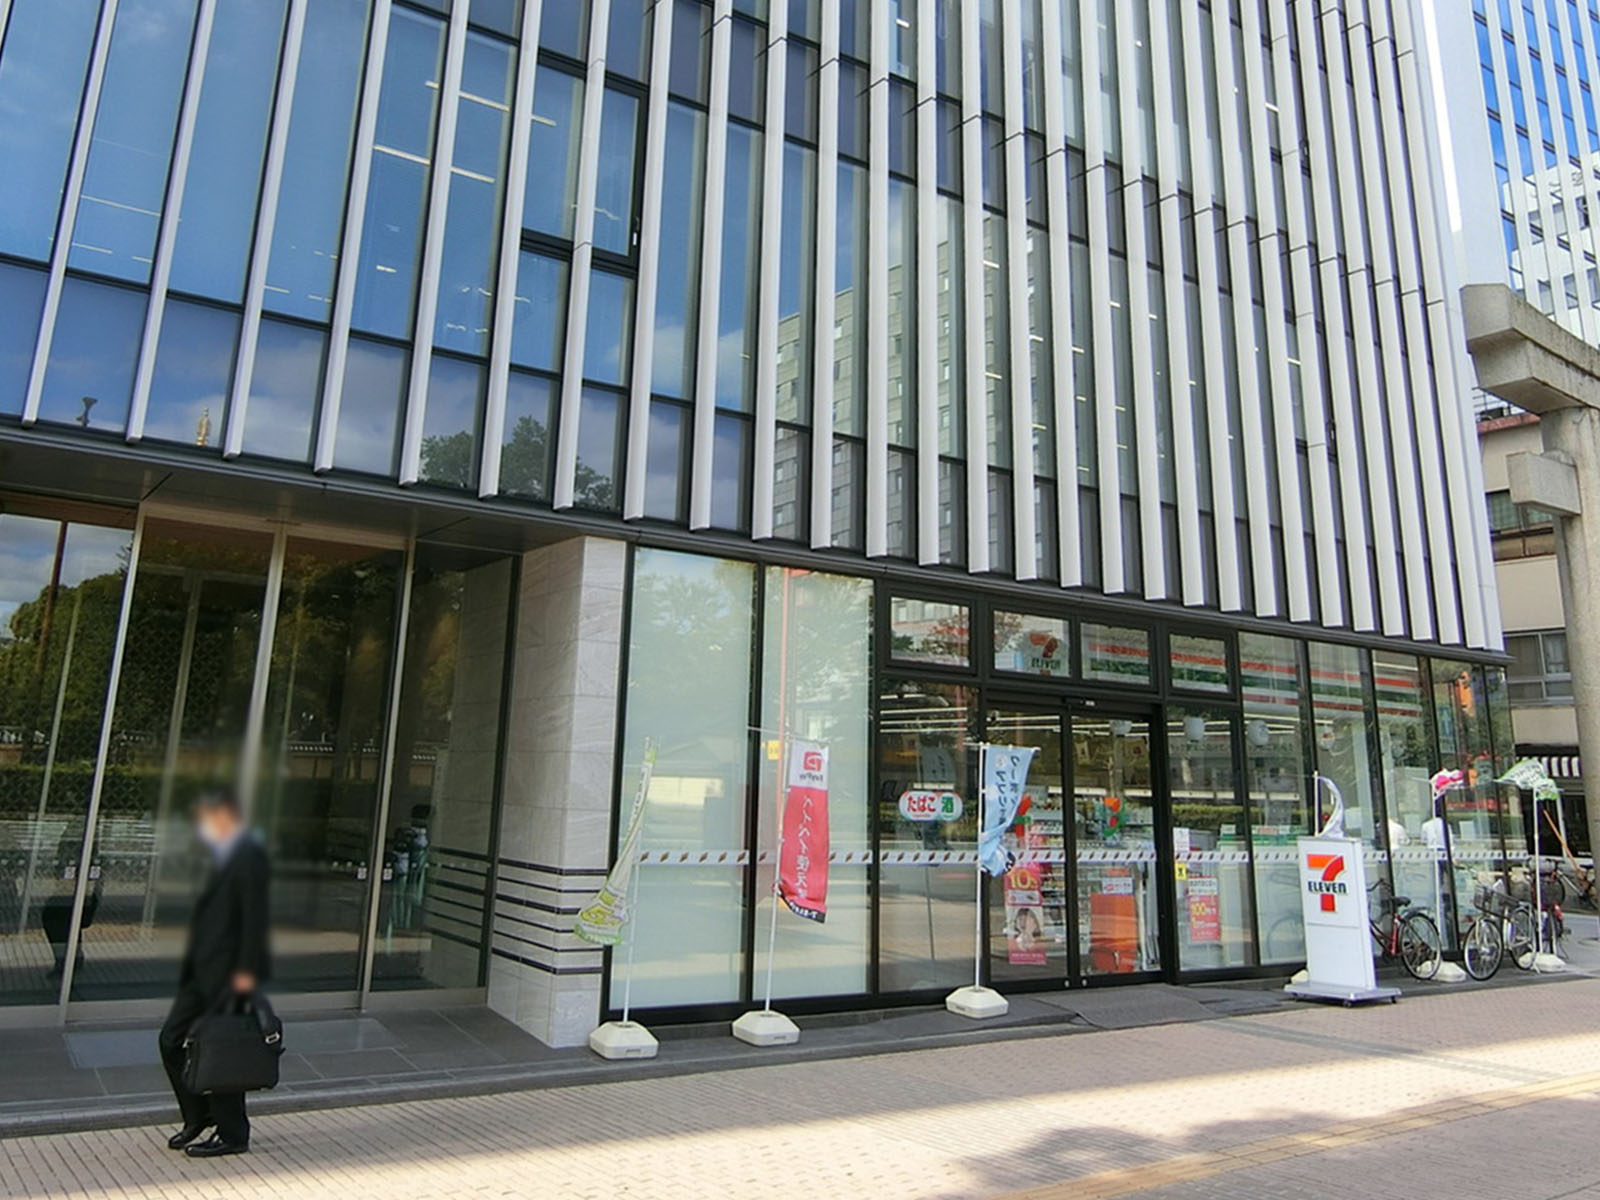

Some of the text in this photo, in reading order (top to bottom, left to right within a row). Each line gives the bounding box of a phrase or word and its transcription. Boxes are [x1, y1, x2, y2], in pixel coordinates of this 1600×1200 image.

[907, 796, 954, 813] たばこ 酒
[1306, 854, 1344, 912] 7
